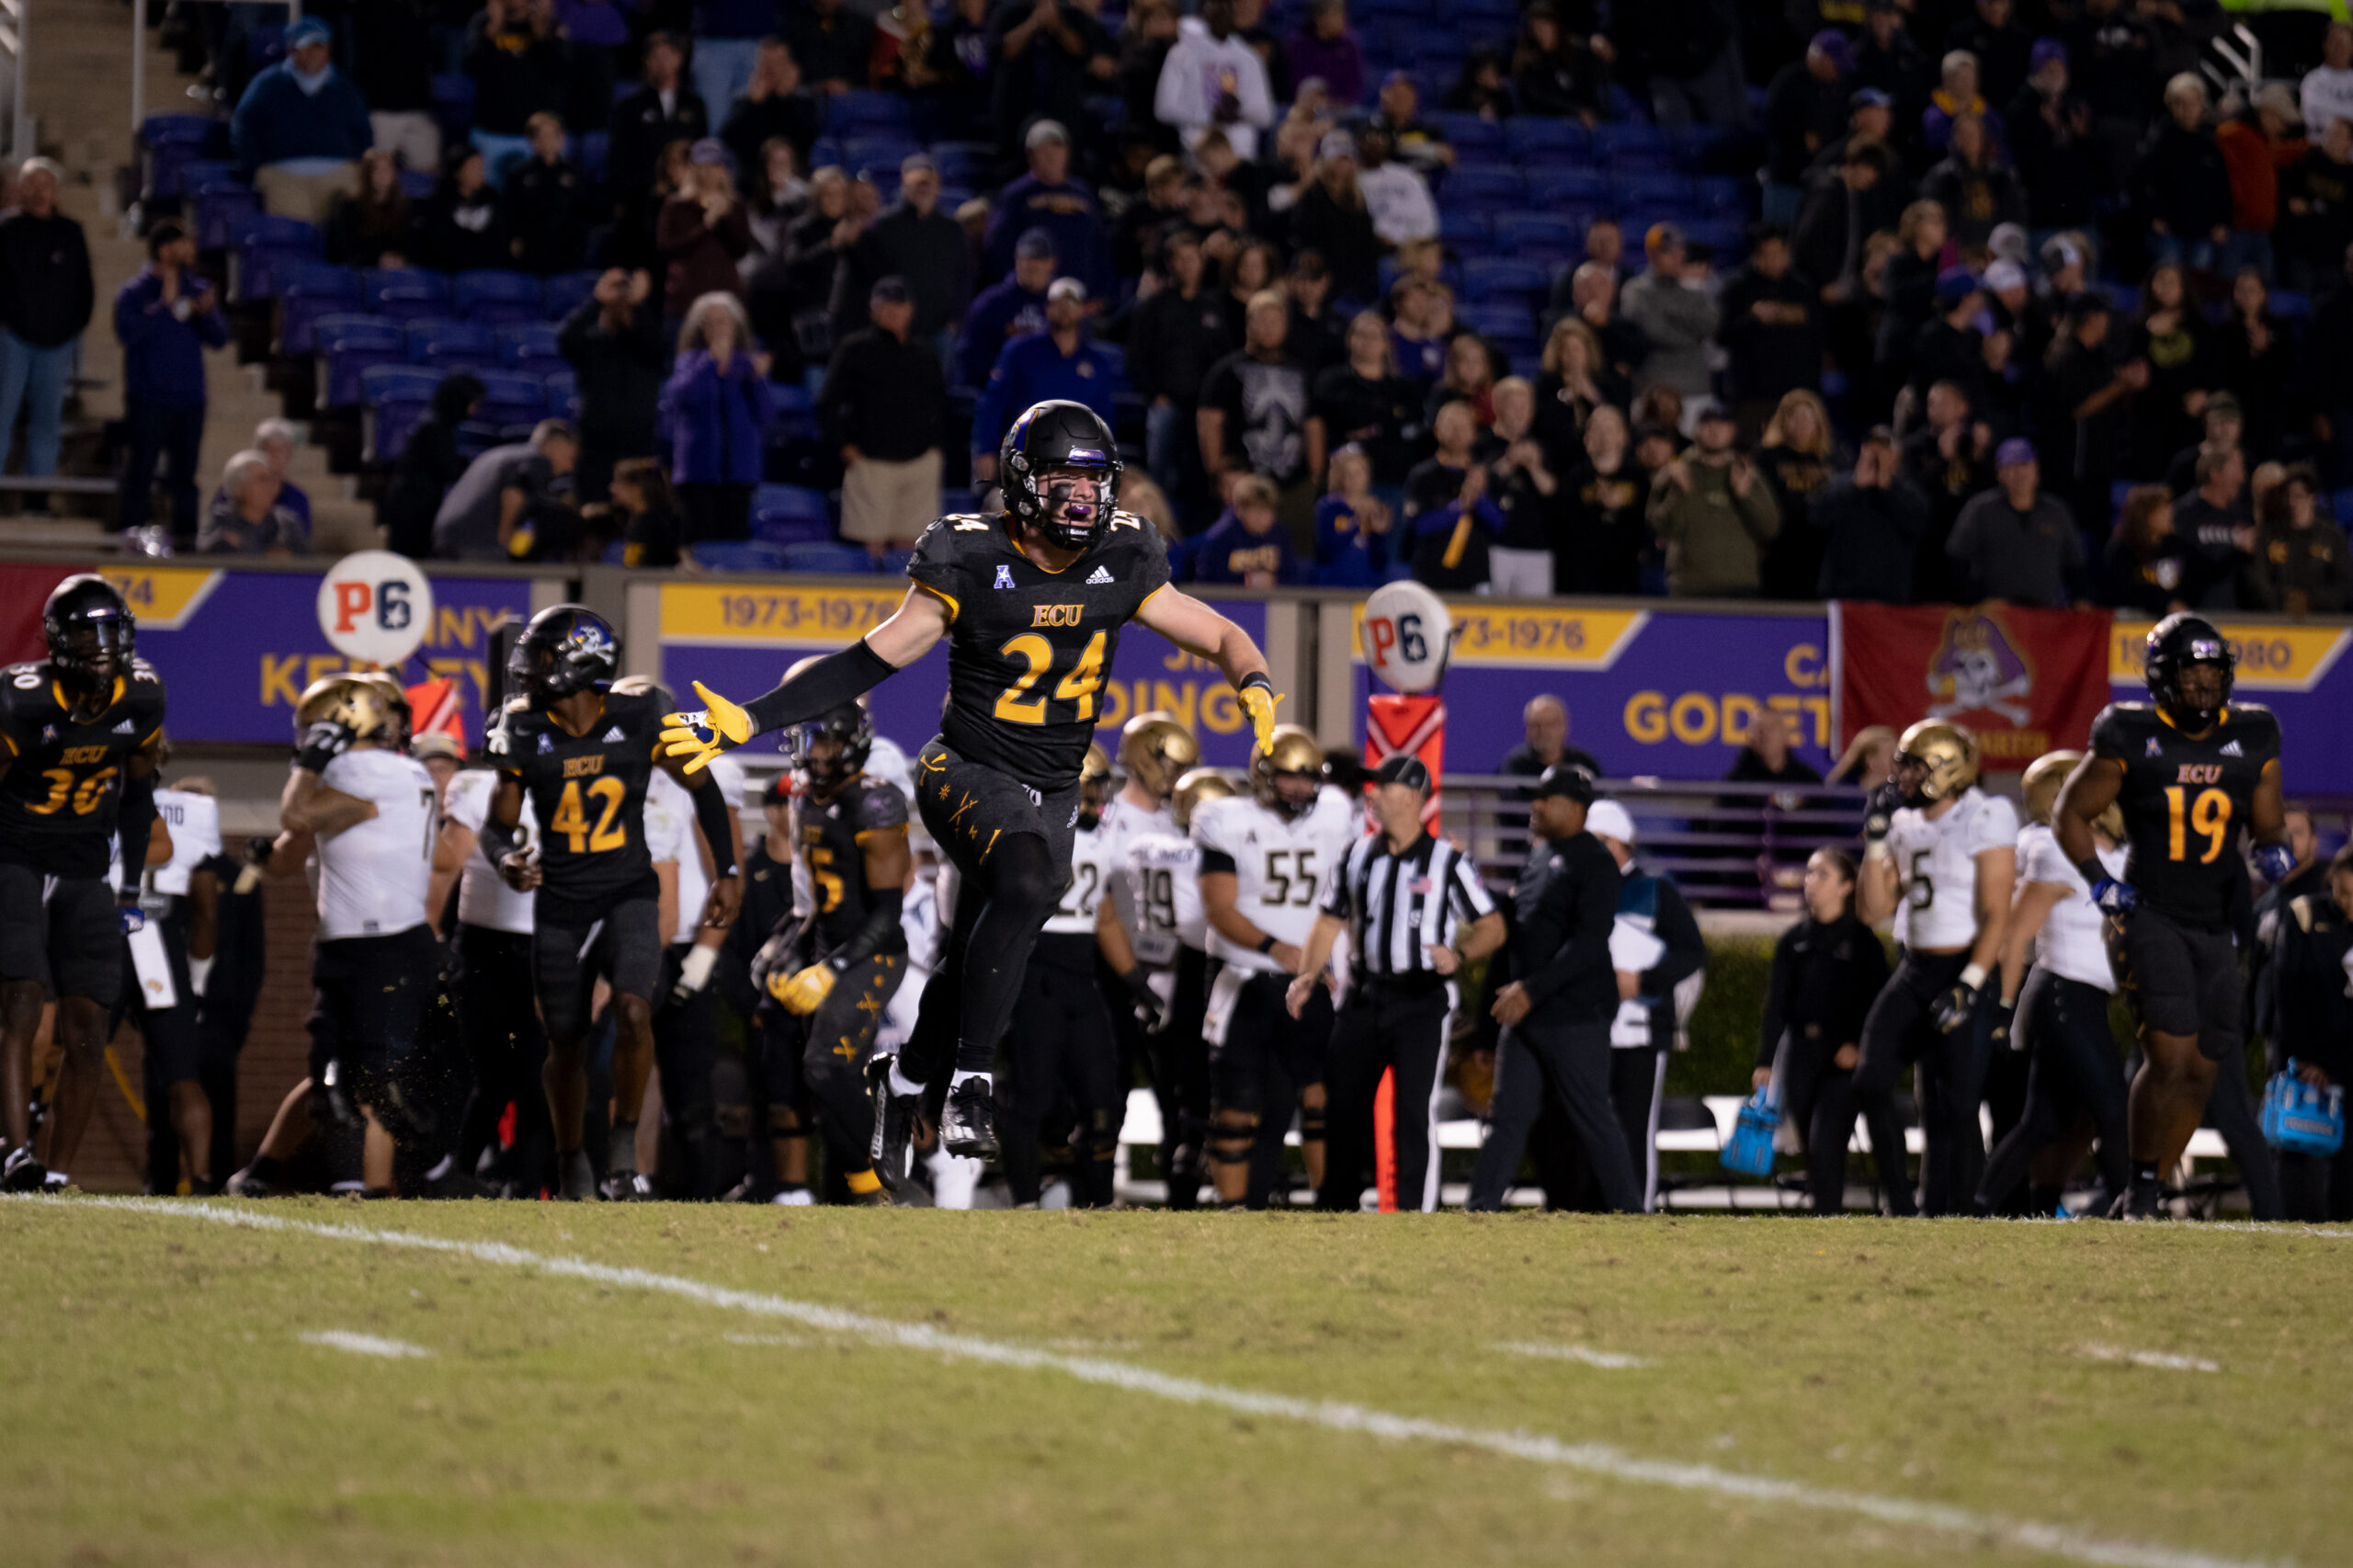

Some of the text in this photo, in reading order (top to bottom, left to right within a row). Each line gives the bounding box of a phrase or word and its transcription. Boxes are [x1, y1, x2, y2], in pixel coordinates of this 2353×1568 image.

[946, 513, 990, 532] 24
[333, 580, 413, 634] P6
[1029, 604, 1085, 628] ECU
[1368, 613, 1428, 668] P6
[8, 665, 42, 689] 30
[992, 630, 1107, 726] 24
[59, 744, 109, 766] ECU
[563, 754, 606, 778] ECU
[2177, 763, 2224, 784] ECU
[419, 786, 436, 861] 7
[551, 776, 627, 853] 42
[2165, 786, 2234, 864] 19
[1141, 866, 1177, 928] 19
[1260, 847, 1317, 907] 55
[1911, 848, 1934, 910] 5
